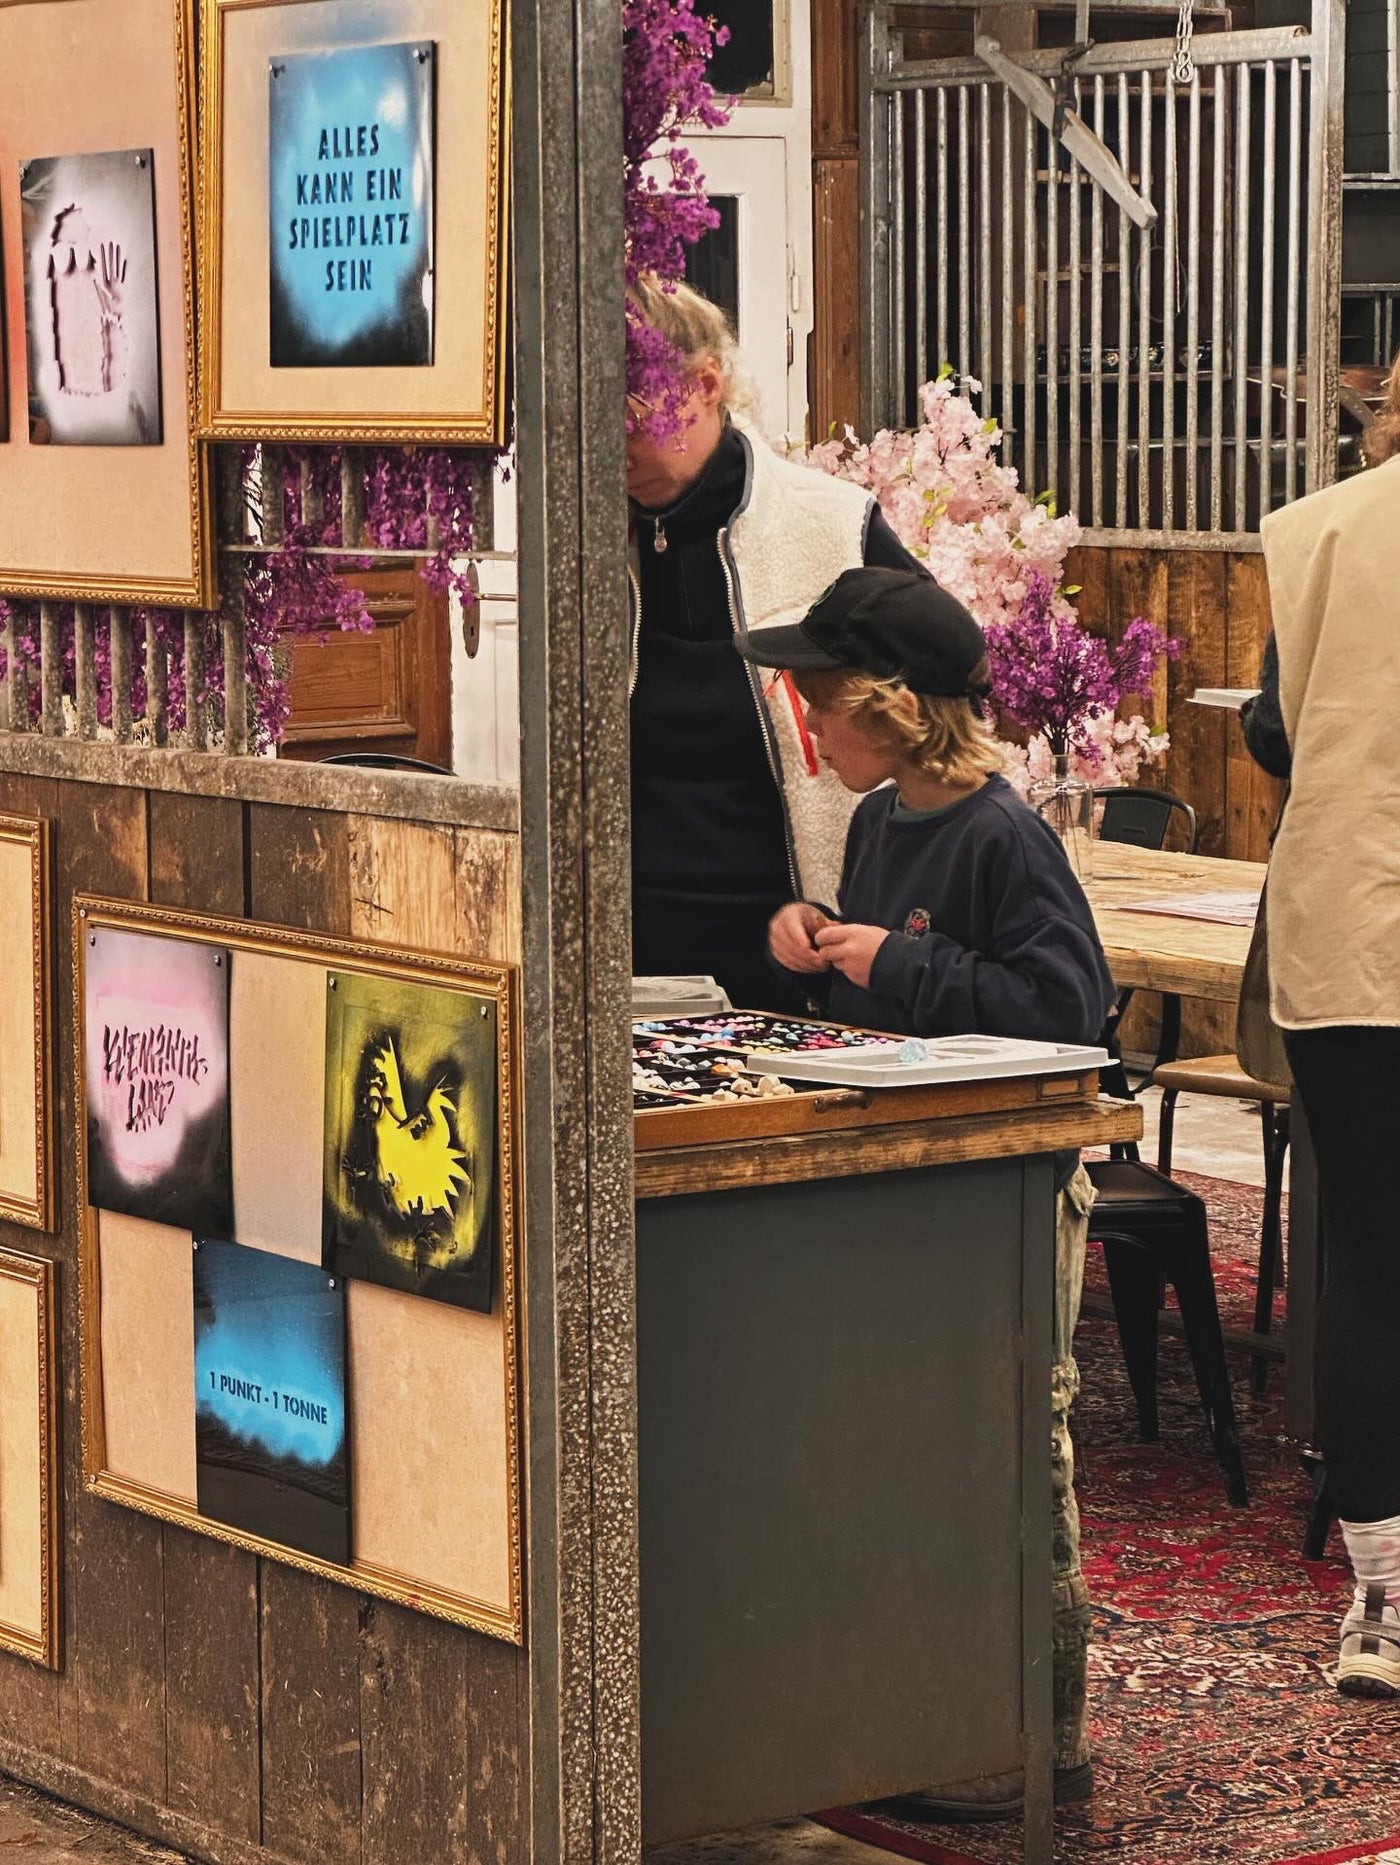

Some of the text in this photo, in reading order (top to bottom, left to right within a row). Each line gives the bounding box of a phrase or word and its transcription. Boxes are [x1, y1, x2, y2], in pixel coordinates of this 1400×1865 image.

[318, 124, 379, 160] ALLES
[296, 168, 402, 205] KANN EIN
[289, 213, 410, 250] SPIELPLATZ
[325, 259, 372, 291] SEIN
[210, 1371, 216, 1389] 1
[220, 1374, 262, 1404] PUNKT
[273, 1391, 278, 1409] 1
[283, 1394, 328, 1425] TONNE
